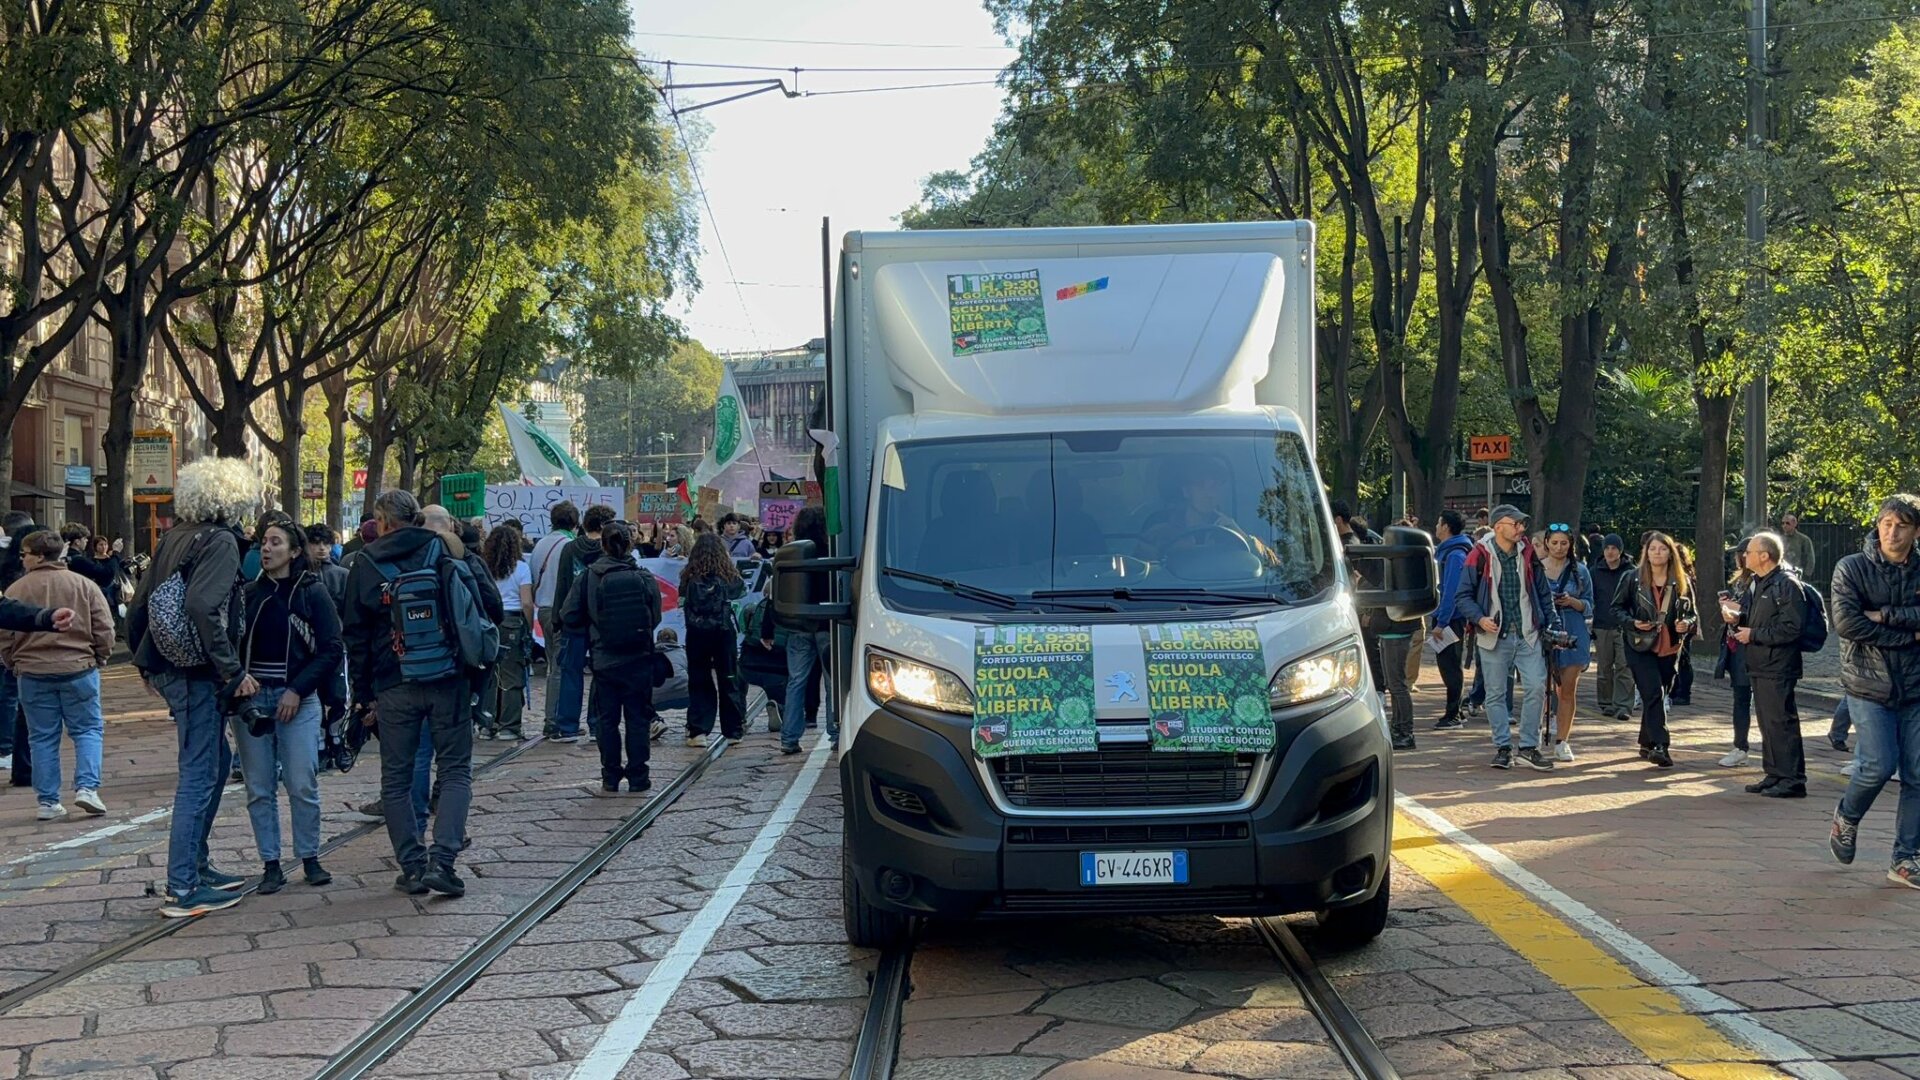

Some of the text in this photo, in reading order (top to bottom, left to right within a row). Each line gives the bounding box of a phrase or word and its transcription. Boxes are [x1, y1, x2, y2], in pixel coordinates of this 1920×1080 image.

[981, 271, 1037, 281] OTTOBRE
[950, 276, 980, 293] 11
[1003, 280, 1038, 290] 9:30
[951, 304, 1008, 314] SCUOLA
[951, 313, 984, 322] VITA
[952, 317, 1013, 332] LIBERTÀ
[1472, 441, 1507, 454] TAXI
[408, 609, 431, 620] LiveU
[1017, 625, 1089, 633] OTTOBRE
[1142, 624, 1182, 641] 11
[1183, 629, 1256, 641] H. 9:30
[979, 627, 1016, 645] 11
[1017, 633, 1089, 644] H. 9:30
[982, 655, 1083, 664] CORTEO STUDENTESCO
[1189, 652, 1254, 660] STUDENTESCO
[976, 667, 1049, 681] SCUOLA
[1148, 663, 1221, 676] SCUOLA
[976, 684, 1016, 697] VITA
[1148, 680, 1190, 692] VITA
[976, 695, 1053, 714] LIBERTÀ
[1151, 692, 1229, 710] LIBERTÀ
[1236, 727, 1271, 735] CONTRO
[1002, 739, 1037, 748] GUERRA
[1046, 736, 1095, 745] GENOCIDIO
[1181, 736, 1216, 744] GUERRA
[1224, 736, 1272, 746] GENOCIDIO
